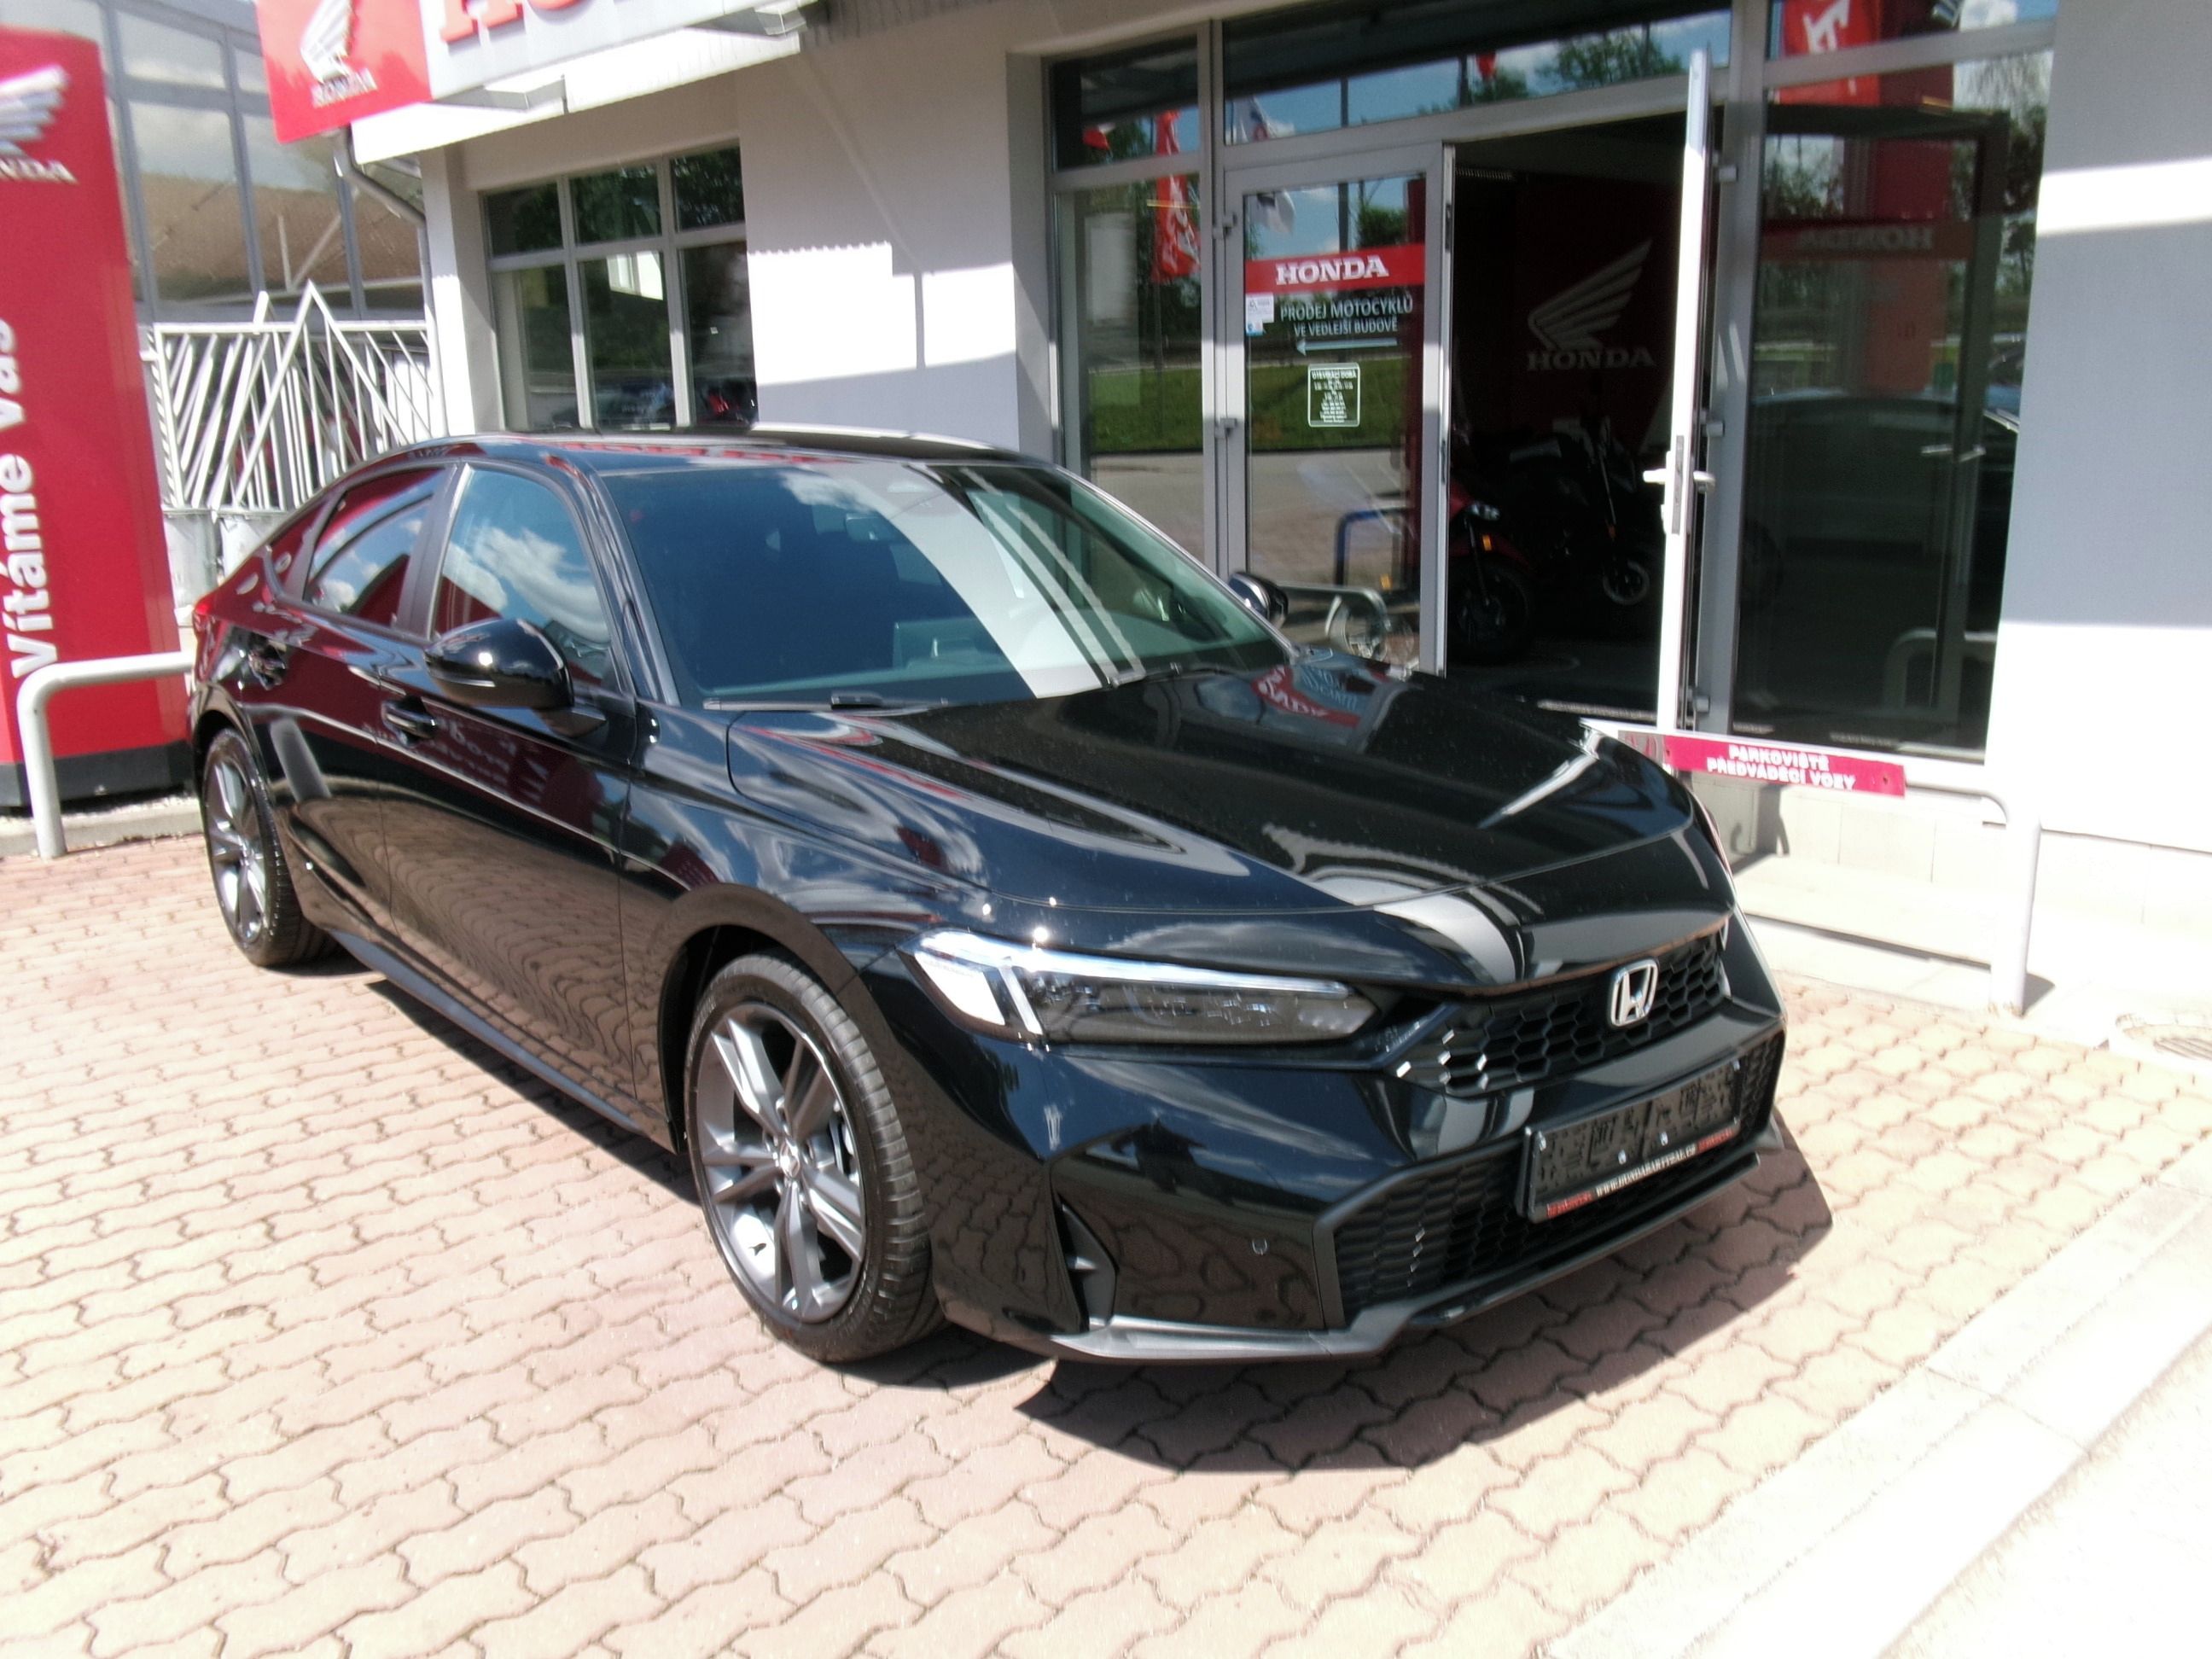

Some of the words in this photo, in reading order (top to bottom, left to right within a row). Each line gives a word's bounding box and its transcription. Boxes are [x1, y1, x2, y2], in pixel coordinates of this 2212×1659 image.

[1276, 255, 1389, 286] HONDA
[1281, 300, 1327, 322] PRODEJ
[1294, 322, 1306, 337] VE
[1527, 346, 1653, 371] HONDA
